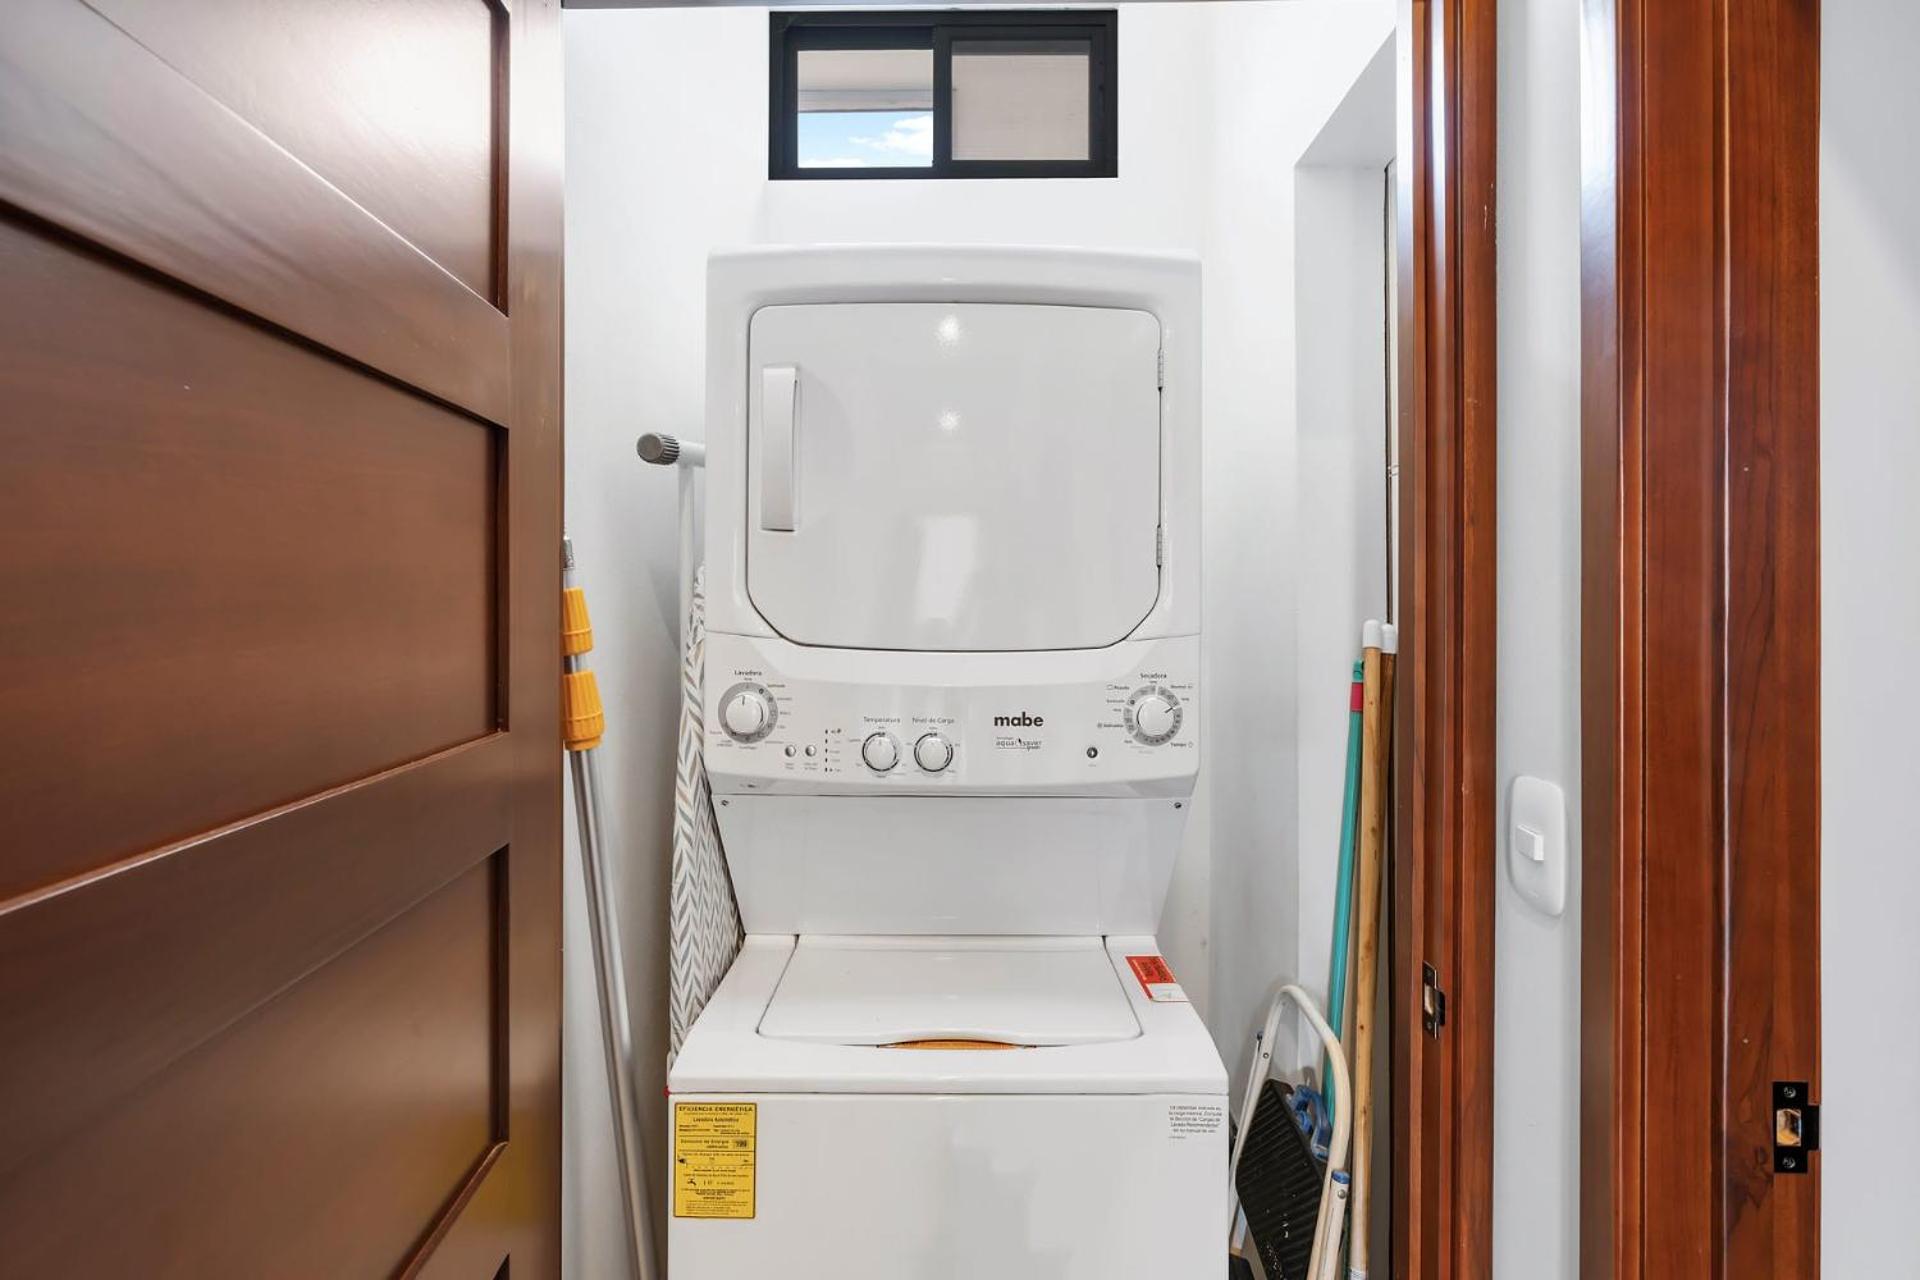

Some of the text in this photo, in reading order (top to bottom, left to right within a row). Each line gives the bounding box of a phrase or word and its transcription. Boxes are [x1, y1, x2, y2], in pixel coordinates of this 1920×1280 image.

[863, 716, 900, 724] Temperatura
[937, 717, 955, 725] Carga
[994, 711, 1044, 727] mabe
